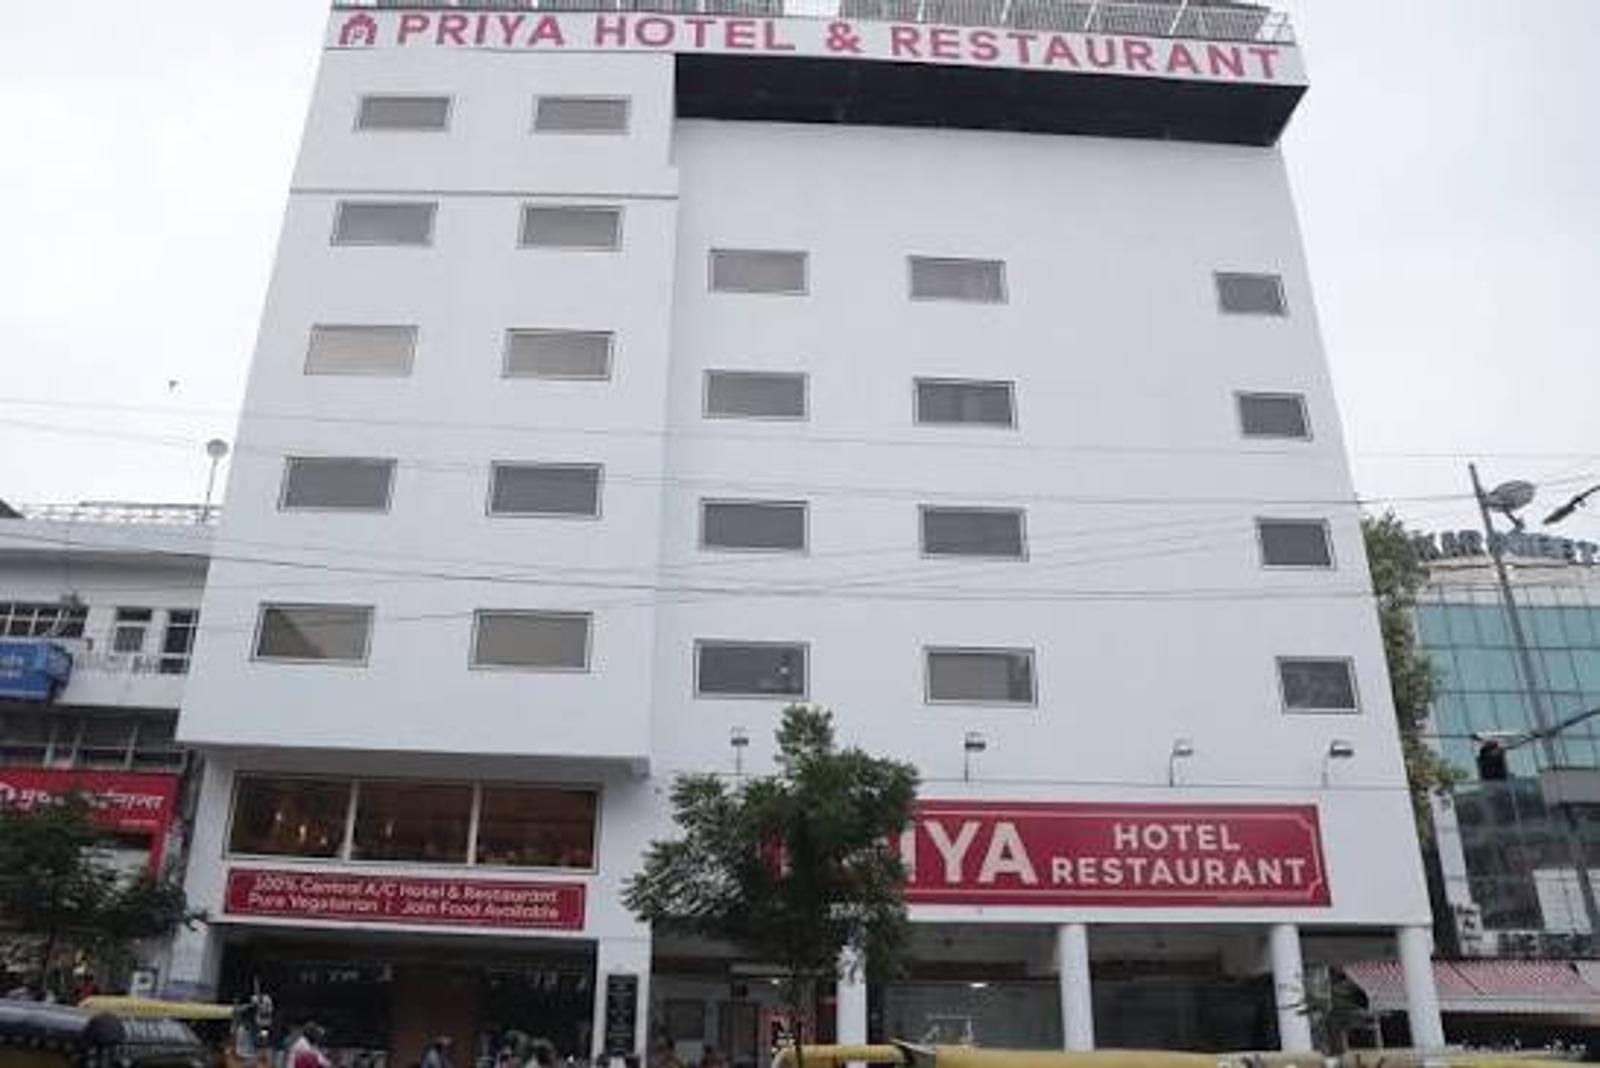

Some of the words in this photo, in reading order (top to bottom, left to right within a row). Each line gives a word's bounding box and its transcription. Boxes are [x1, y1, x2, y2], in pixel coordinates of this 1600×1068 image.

[397, 13, 565, 46] PRIYA
[594, 16, 796, 51] HOTEL
[825, 21, 863, 54] &
[890, 25, 1280, 80] RESTAURANT
[1114, 823, 1241, 852] HOTEL
[1051, 856, 1307, 887] RESTAURANT
[248, 892, 288, 908] Pure
[440, 902, 481, 916] Food
[484, 905, 559, 920] Available
[400, 884, 446, 899] Hotel
[447, 885, 460, 900] &
[464, 886, 558, 904] Restaurant
